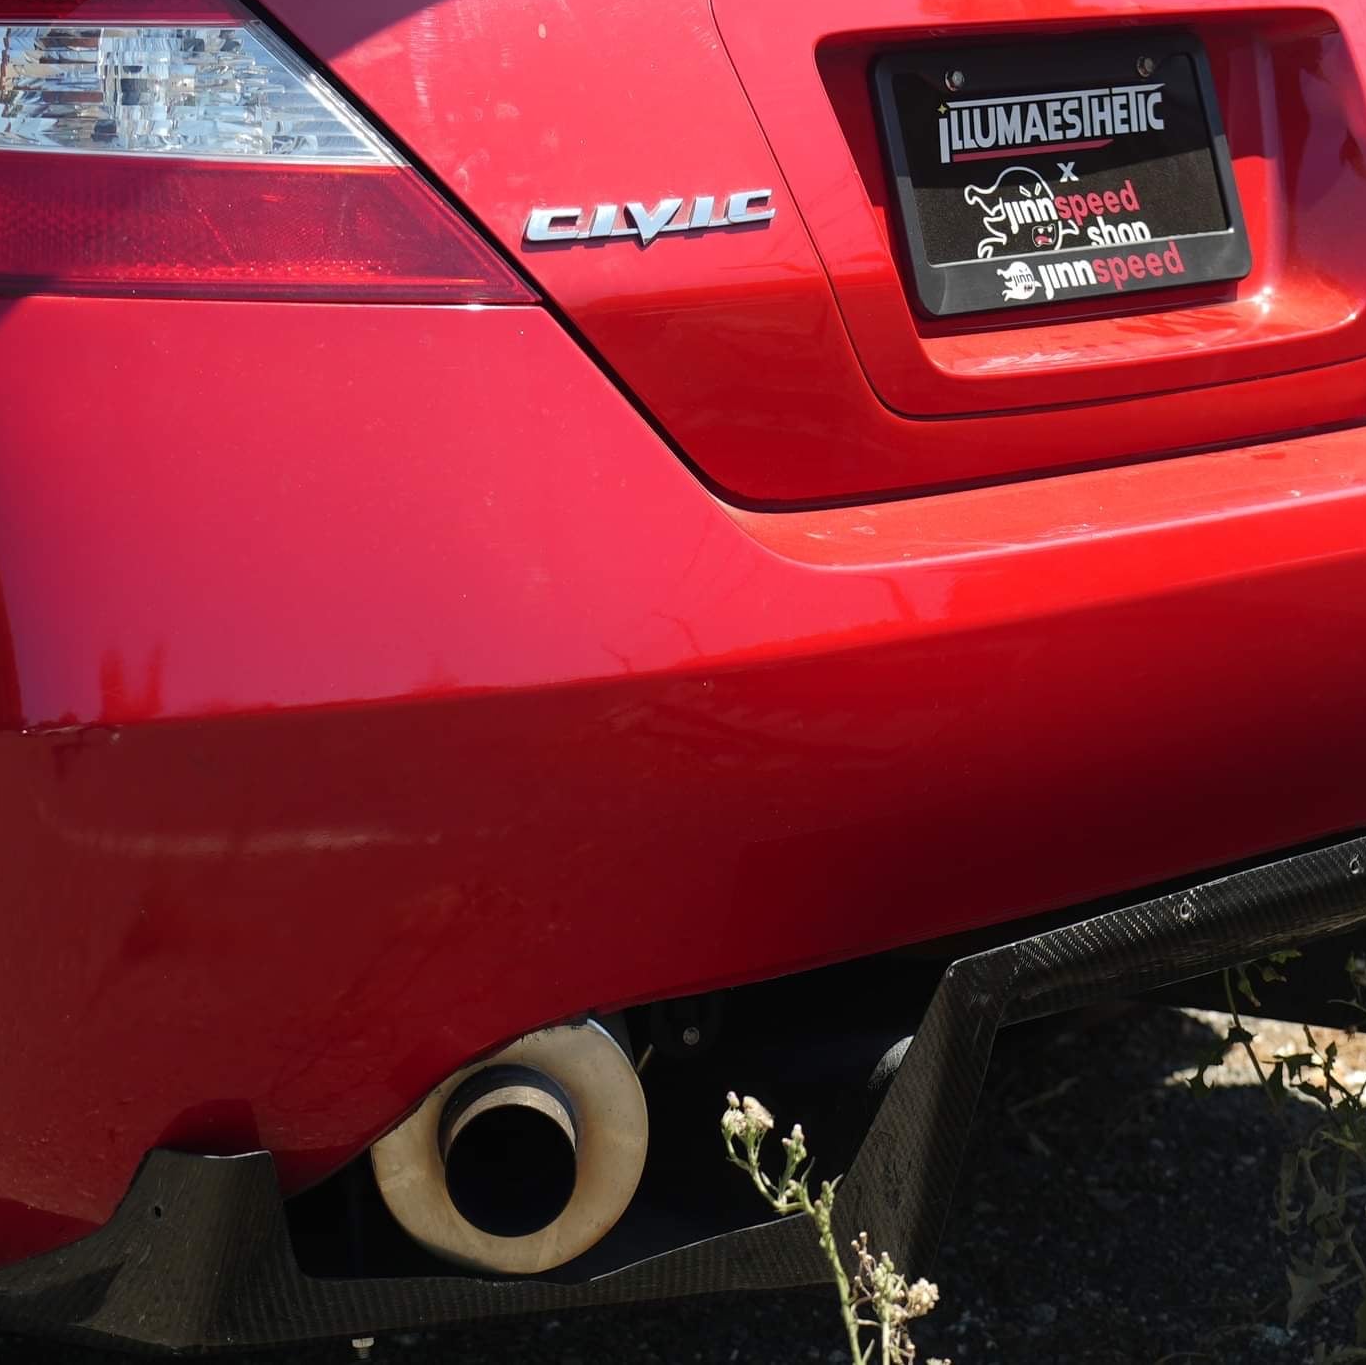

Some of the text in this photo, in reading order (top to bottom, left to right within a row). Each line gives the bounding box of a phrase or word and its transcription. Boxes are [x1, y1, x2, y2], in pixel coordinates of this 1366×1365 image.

[524, 188, 776, 246] CIVIC
[1004, 179, 1141, 235] jinnspeed
[1087, 216, 1152, 248] shop
[1037, 240, 1185, 301] jinnspeed
